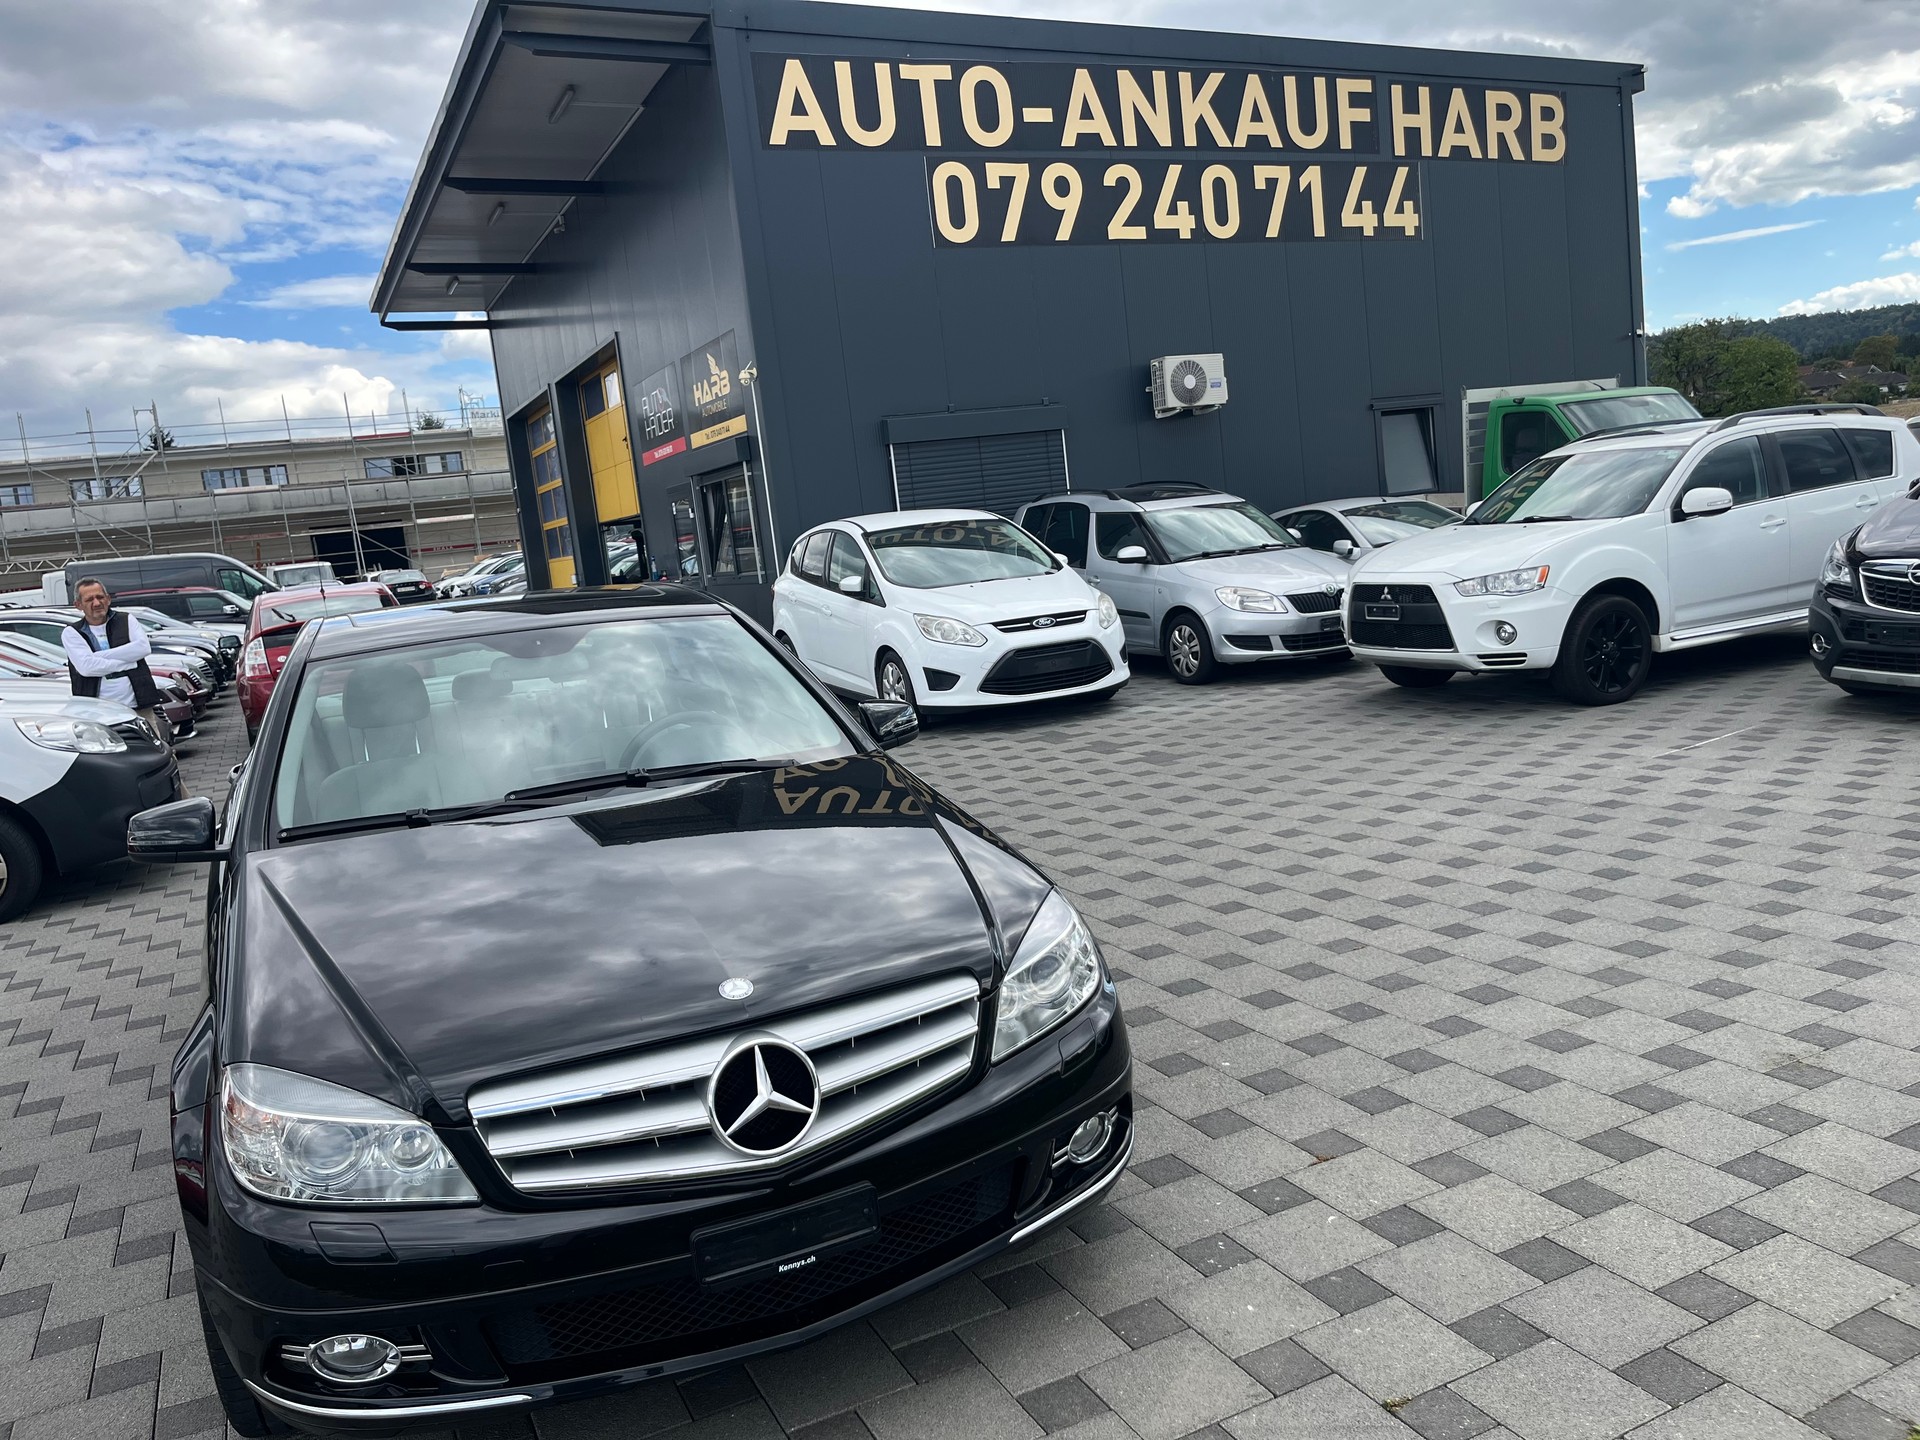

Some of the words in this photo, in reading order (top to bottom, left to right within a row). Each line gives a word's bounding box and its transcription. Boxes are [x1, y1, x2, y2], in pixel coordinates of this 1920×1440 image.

[769, 59, 1373, 150] AUTO-ANKAUF
[1391, 84, 1566, 162] HARB
[932, 161, 1083, 244] 079
[692, 369, 731, 407] HARB
[778, 1255, 816, 1272] Kennys.ch
